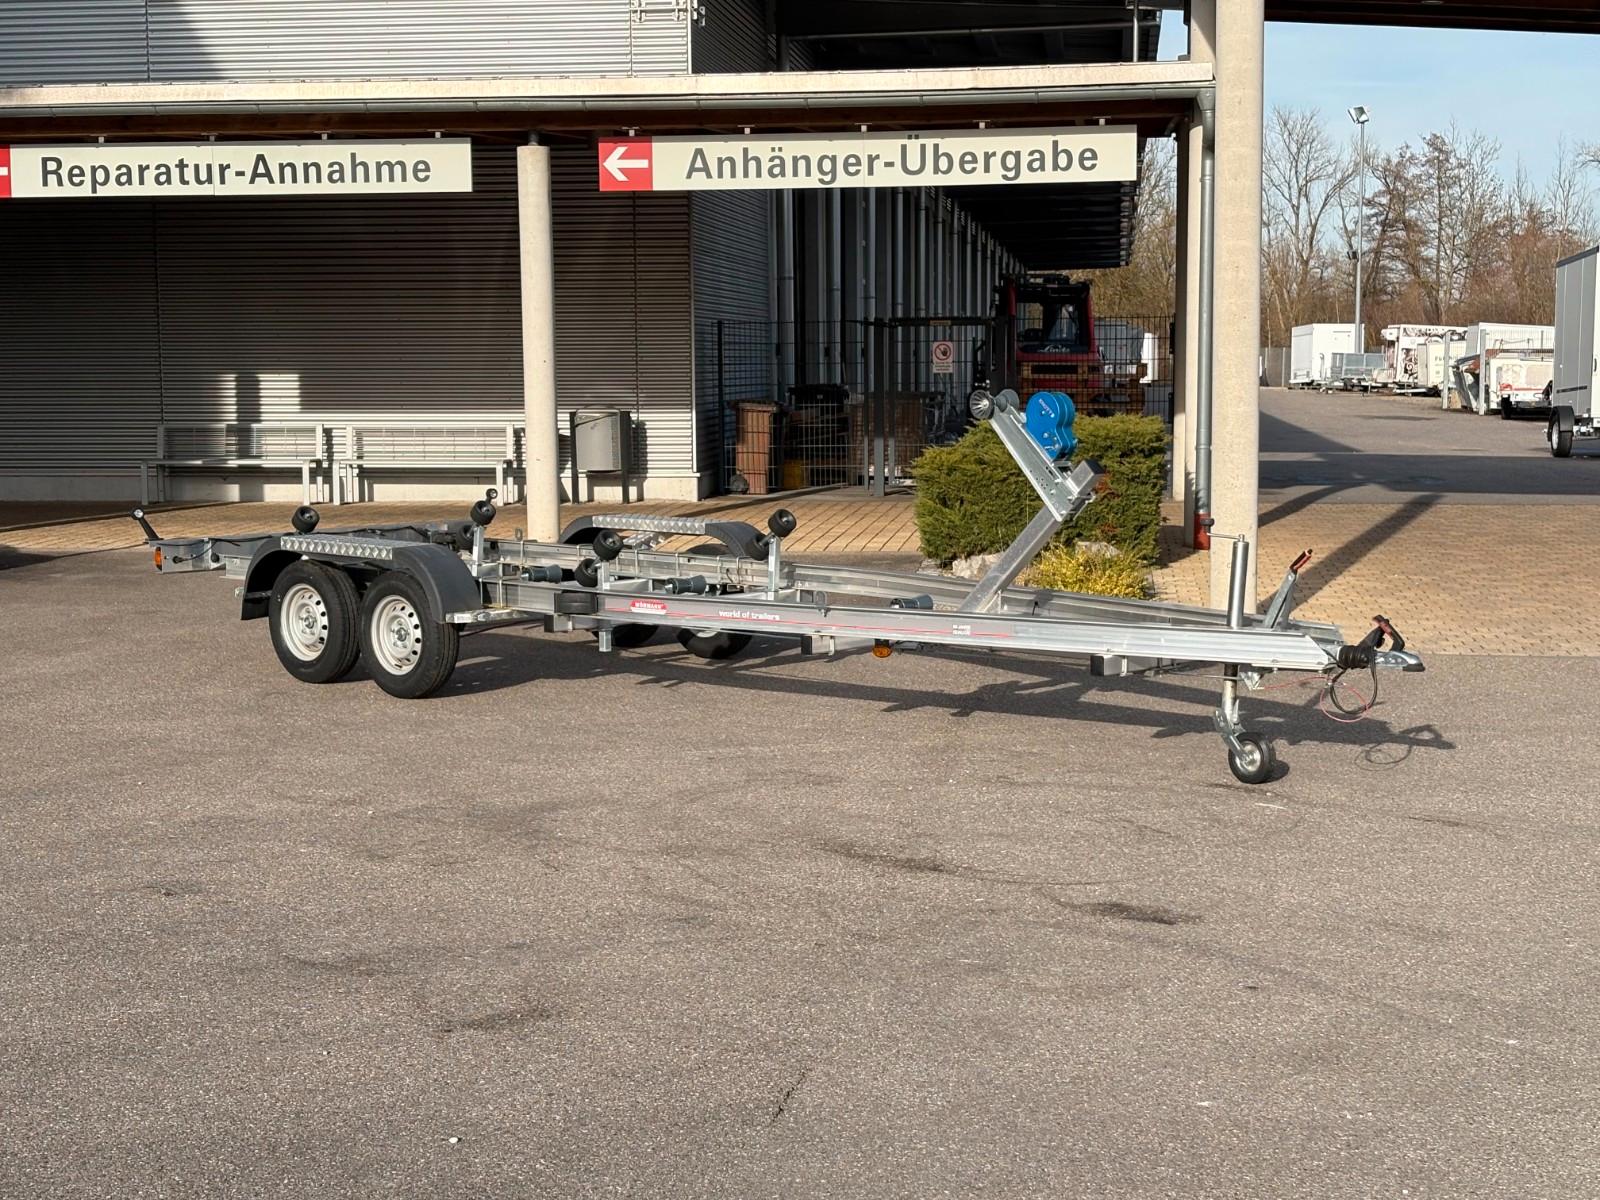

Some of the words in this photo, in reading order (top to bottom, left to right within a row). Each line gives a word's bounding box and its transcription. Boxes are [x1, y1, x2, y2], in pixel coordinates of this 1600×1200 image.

[40, 152, 432, 195] Reparatur-Annahme
[686, 134, 1098, 187] Anhänger-Übergabe
[719, 609, 740, 618] world
[741, 611, 750, 619] of
[751, 611, 780, 621] trailers
